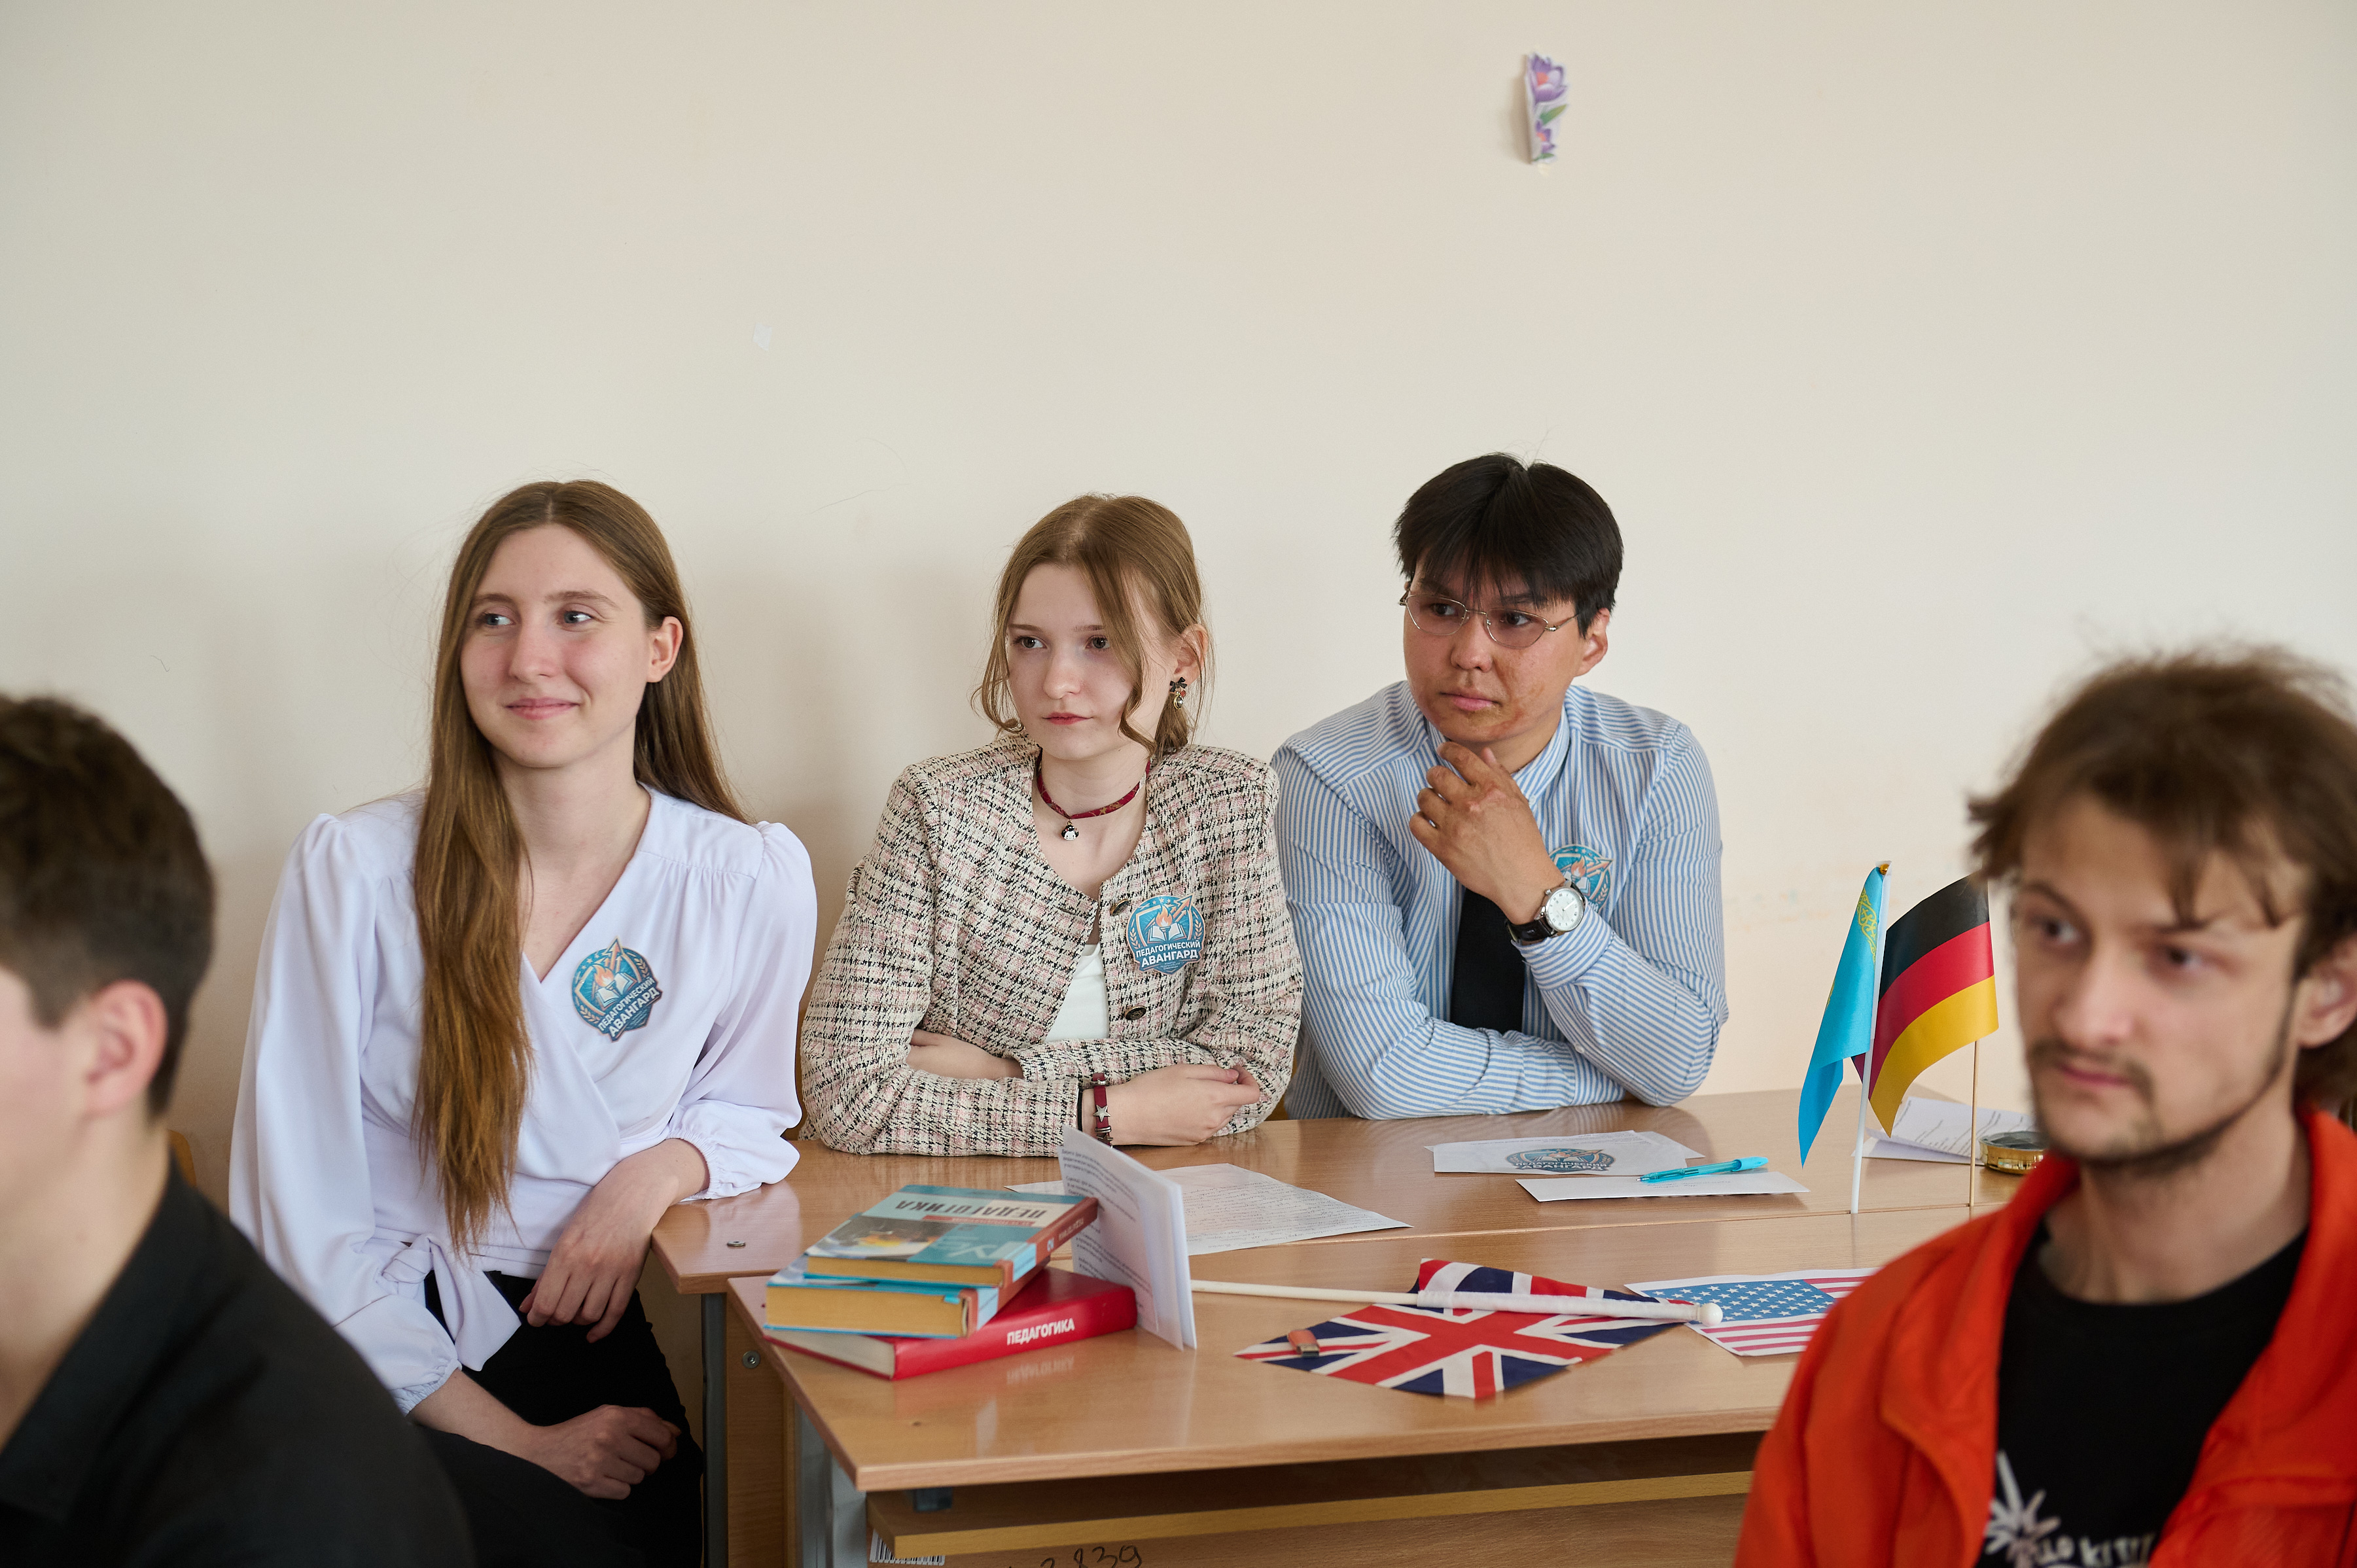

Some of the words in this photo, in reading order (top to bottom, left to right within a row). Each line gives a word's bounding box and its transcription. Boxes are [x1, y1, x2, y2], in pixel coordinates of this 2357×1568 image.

[1137, 941, 1200, 958] ПЕДАГОГИЧЕСКИЙ
[1142, 950, 1197, 967] АВАНГАРД
[598, 977, 654, 1031] ПЕДАГОГИЧЕСКИЙ
[609, 986, 660, 1037] АВАНГАРД
[895, 1201, 1046, 1219] ПЕДАГОГИКА
[1007, 1318, 1074, 1345] ПЕДАГОГИКА
